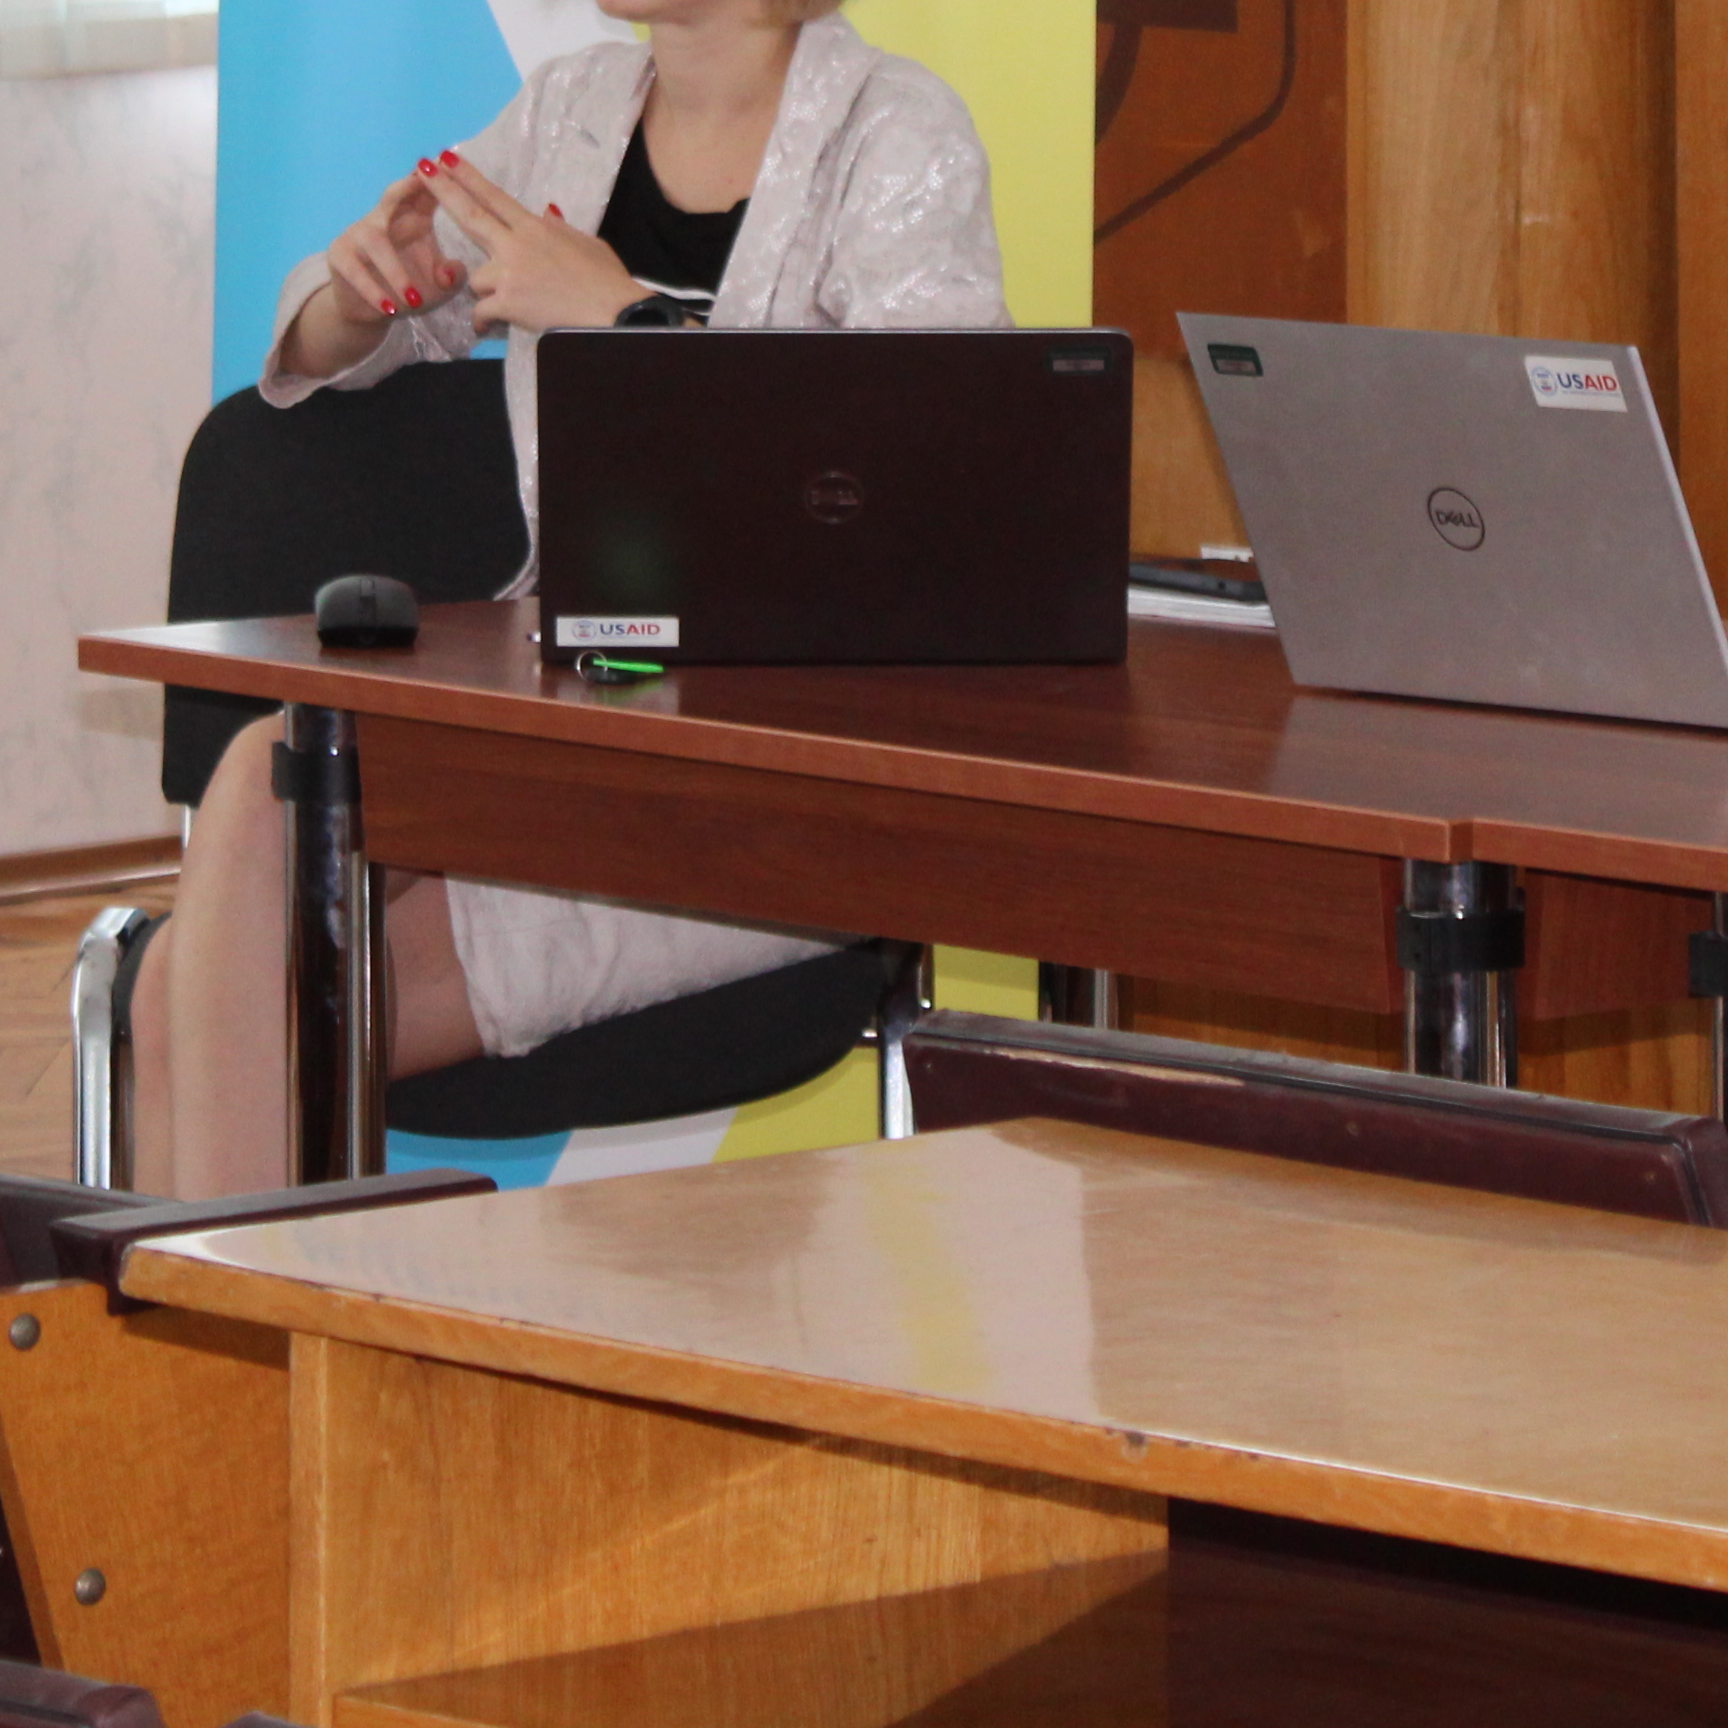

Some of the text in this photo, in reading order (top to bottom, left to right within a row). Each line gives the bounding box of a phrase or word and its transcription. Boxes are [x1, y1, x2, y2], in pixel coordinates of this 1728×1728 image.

[1557, 373, 1617, 390] USAID
[1436, 511, 1478, 527] DELL
[600, 623, 660, 635] USAID
